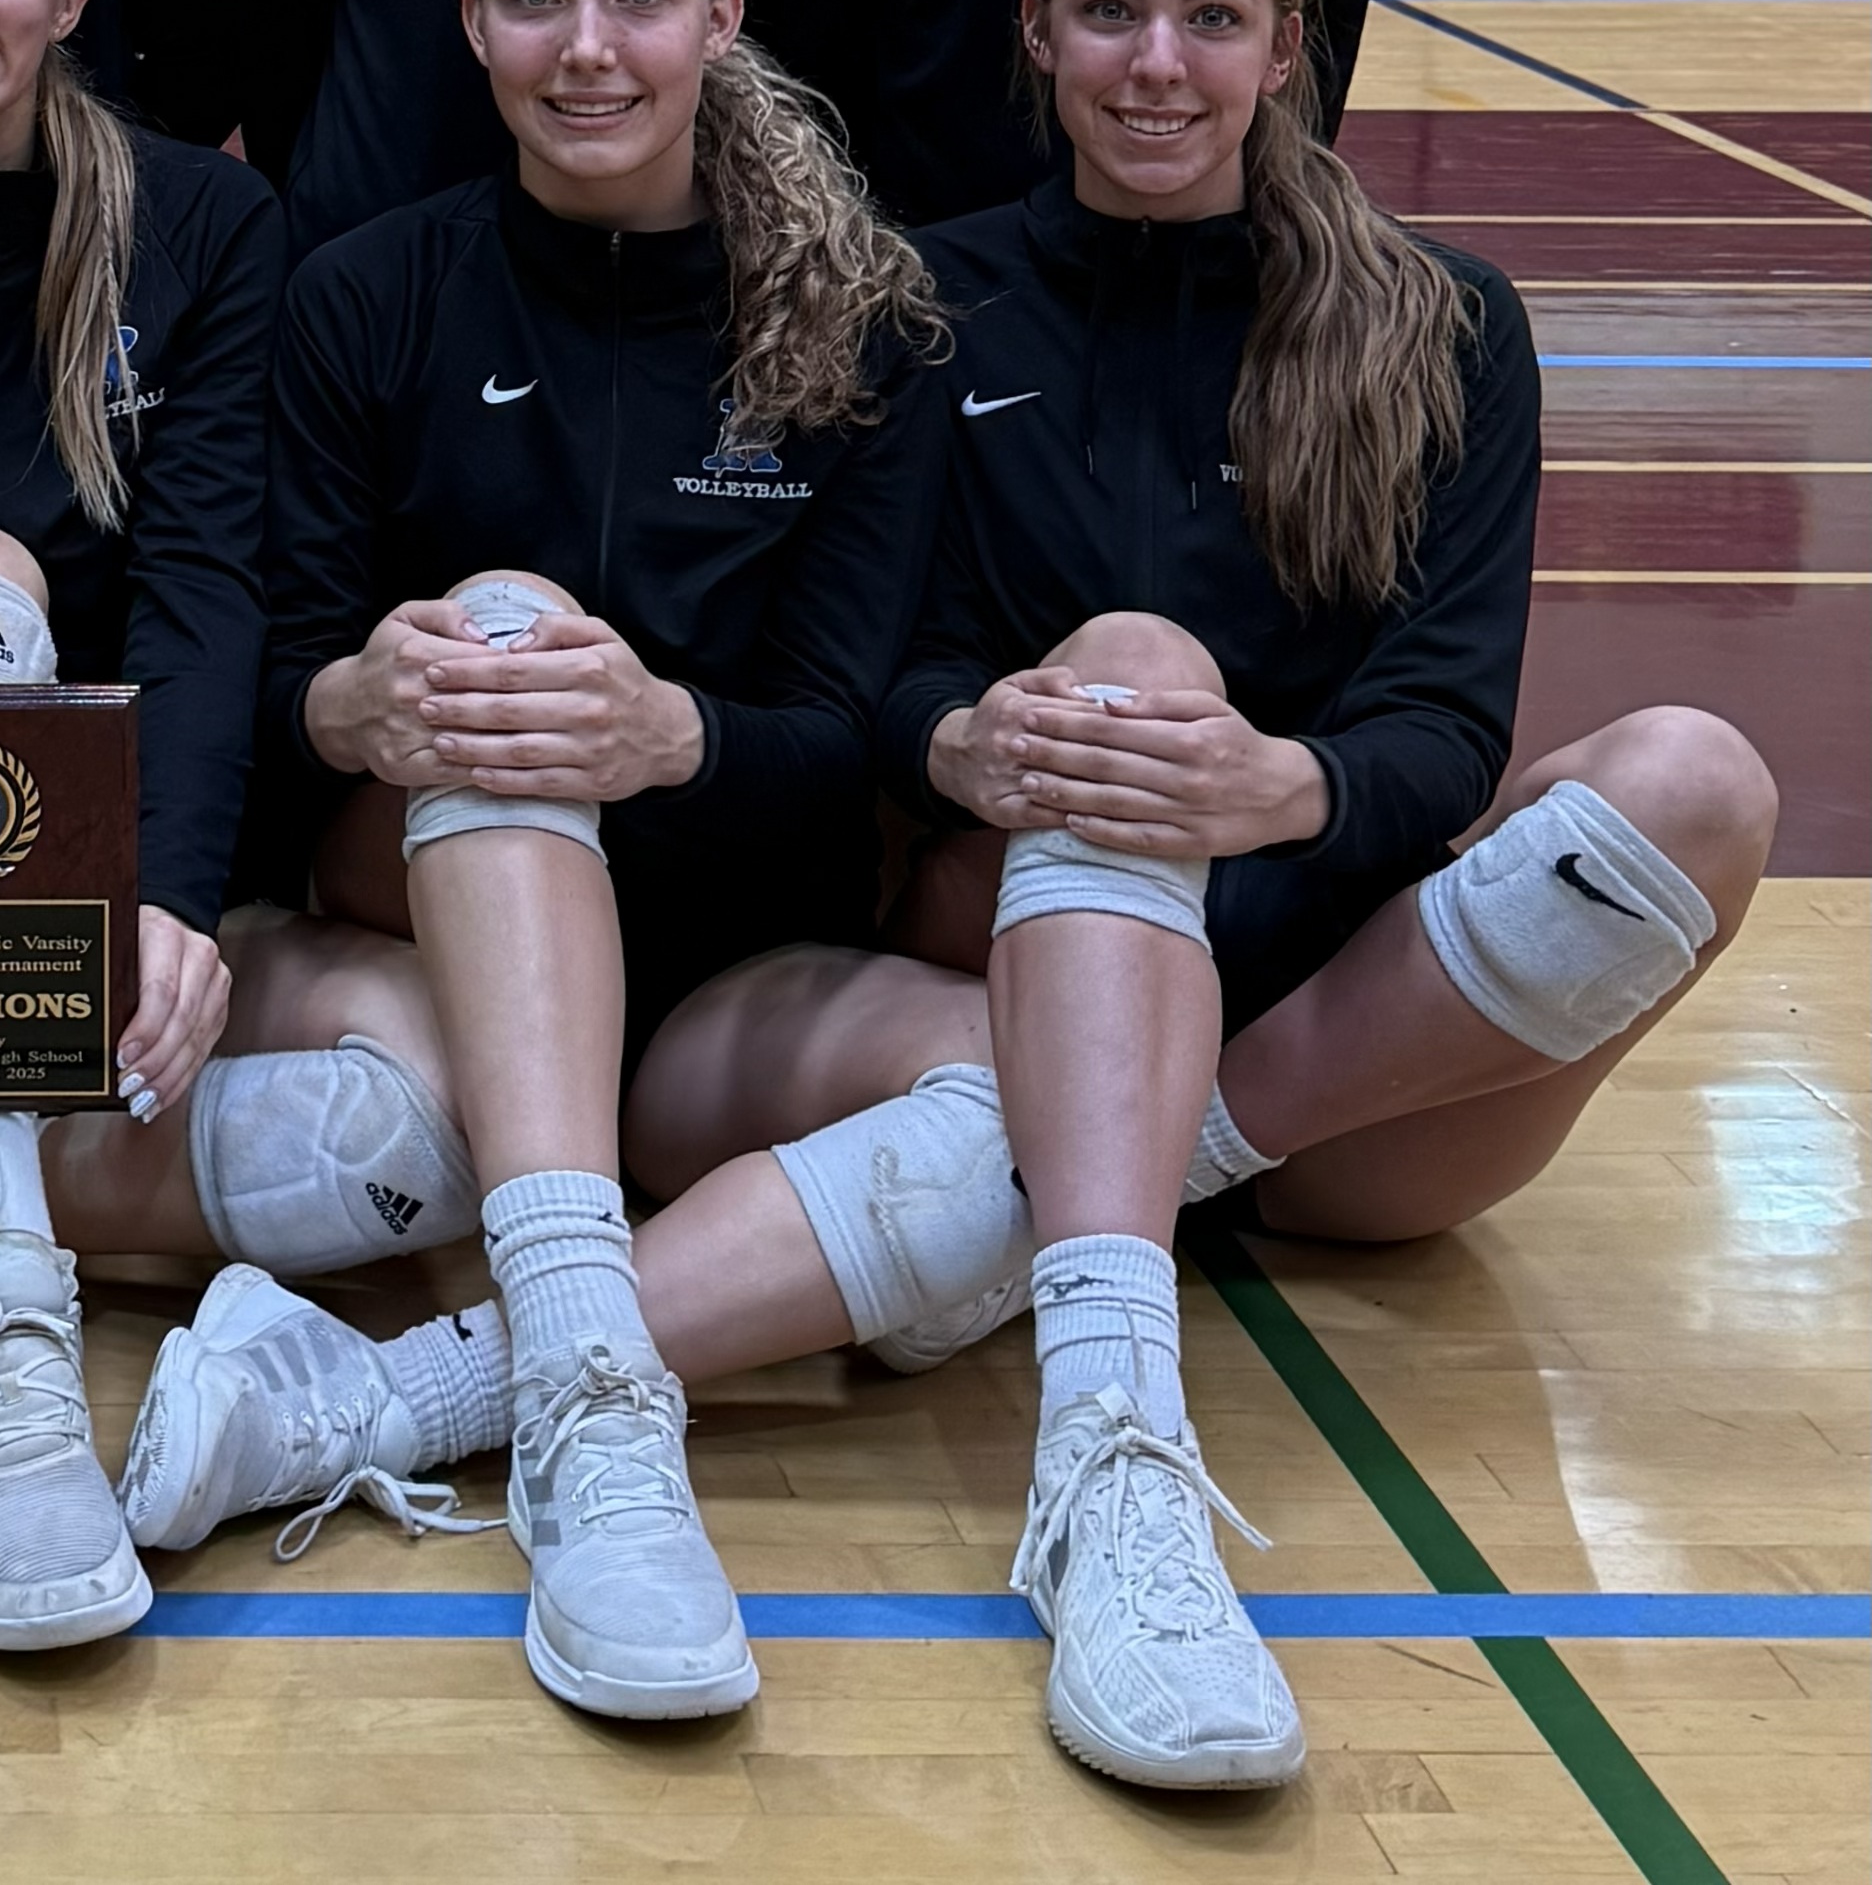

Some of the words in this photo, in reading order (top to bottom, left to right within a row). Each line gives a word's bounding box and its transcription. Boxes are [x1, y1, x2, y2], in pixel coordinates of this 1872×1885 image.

[673, 477, 813, 499] VOLLEYBALL
[22, 935, 93, 954] Varsity
[28, 1051, 83, 1063] School
[6, 1067, 46, 1080] 2025
[365, 1182, 408, 1236] adidas
